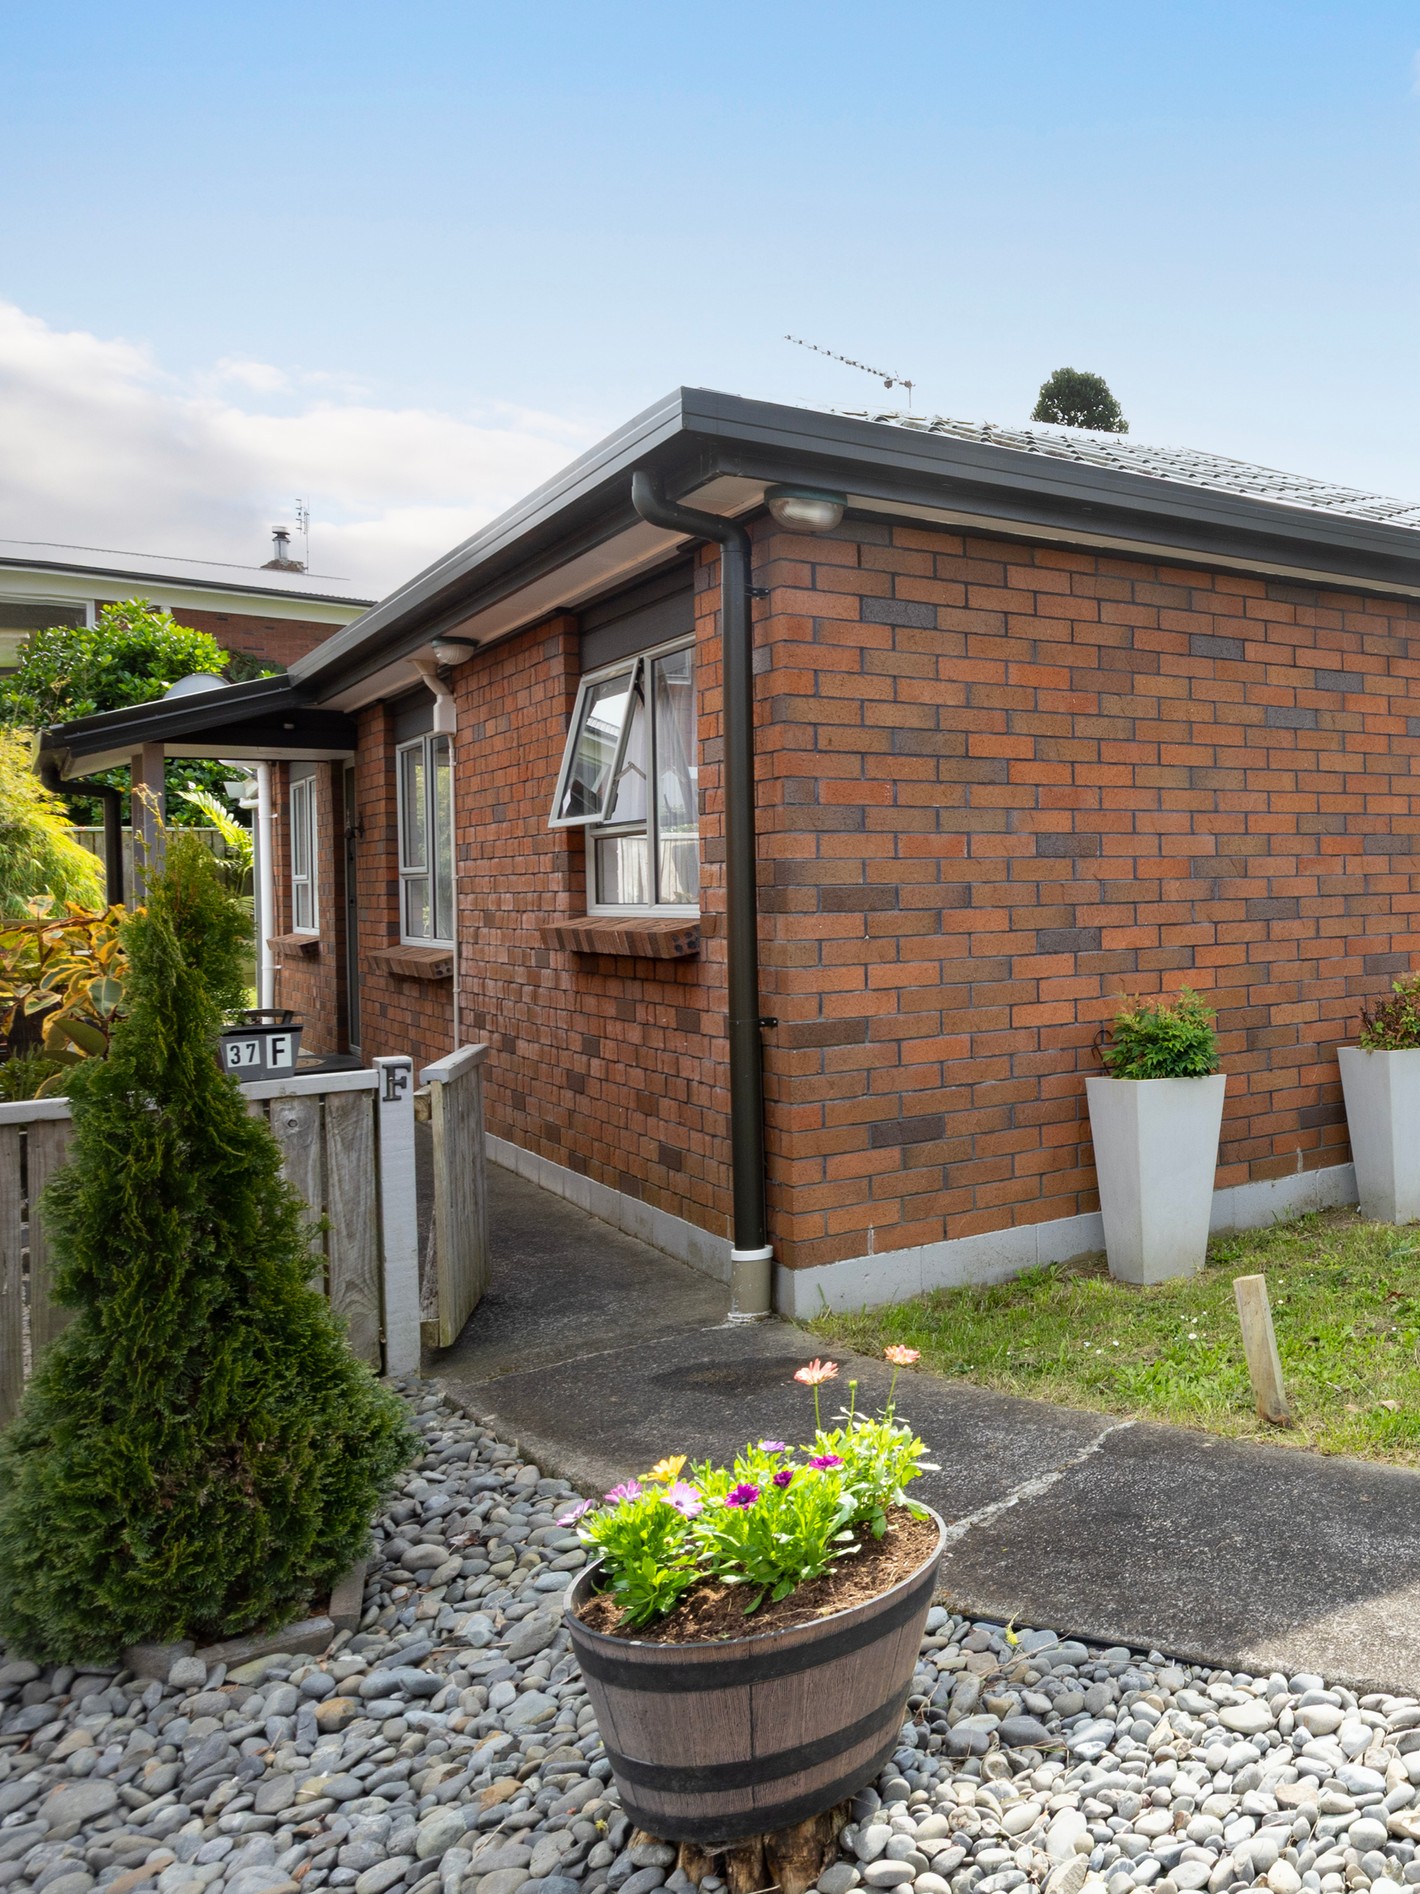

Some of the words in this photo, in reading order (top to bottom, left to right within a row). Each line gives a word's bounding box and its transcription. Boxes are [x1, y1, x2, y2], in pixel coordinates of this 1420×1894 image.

[230, 1043, 256, 1065] 37
[272, 1037, 286, 1066] F
[382, 1063, 412, 1102] F
